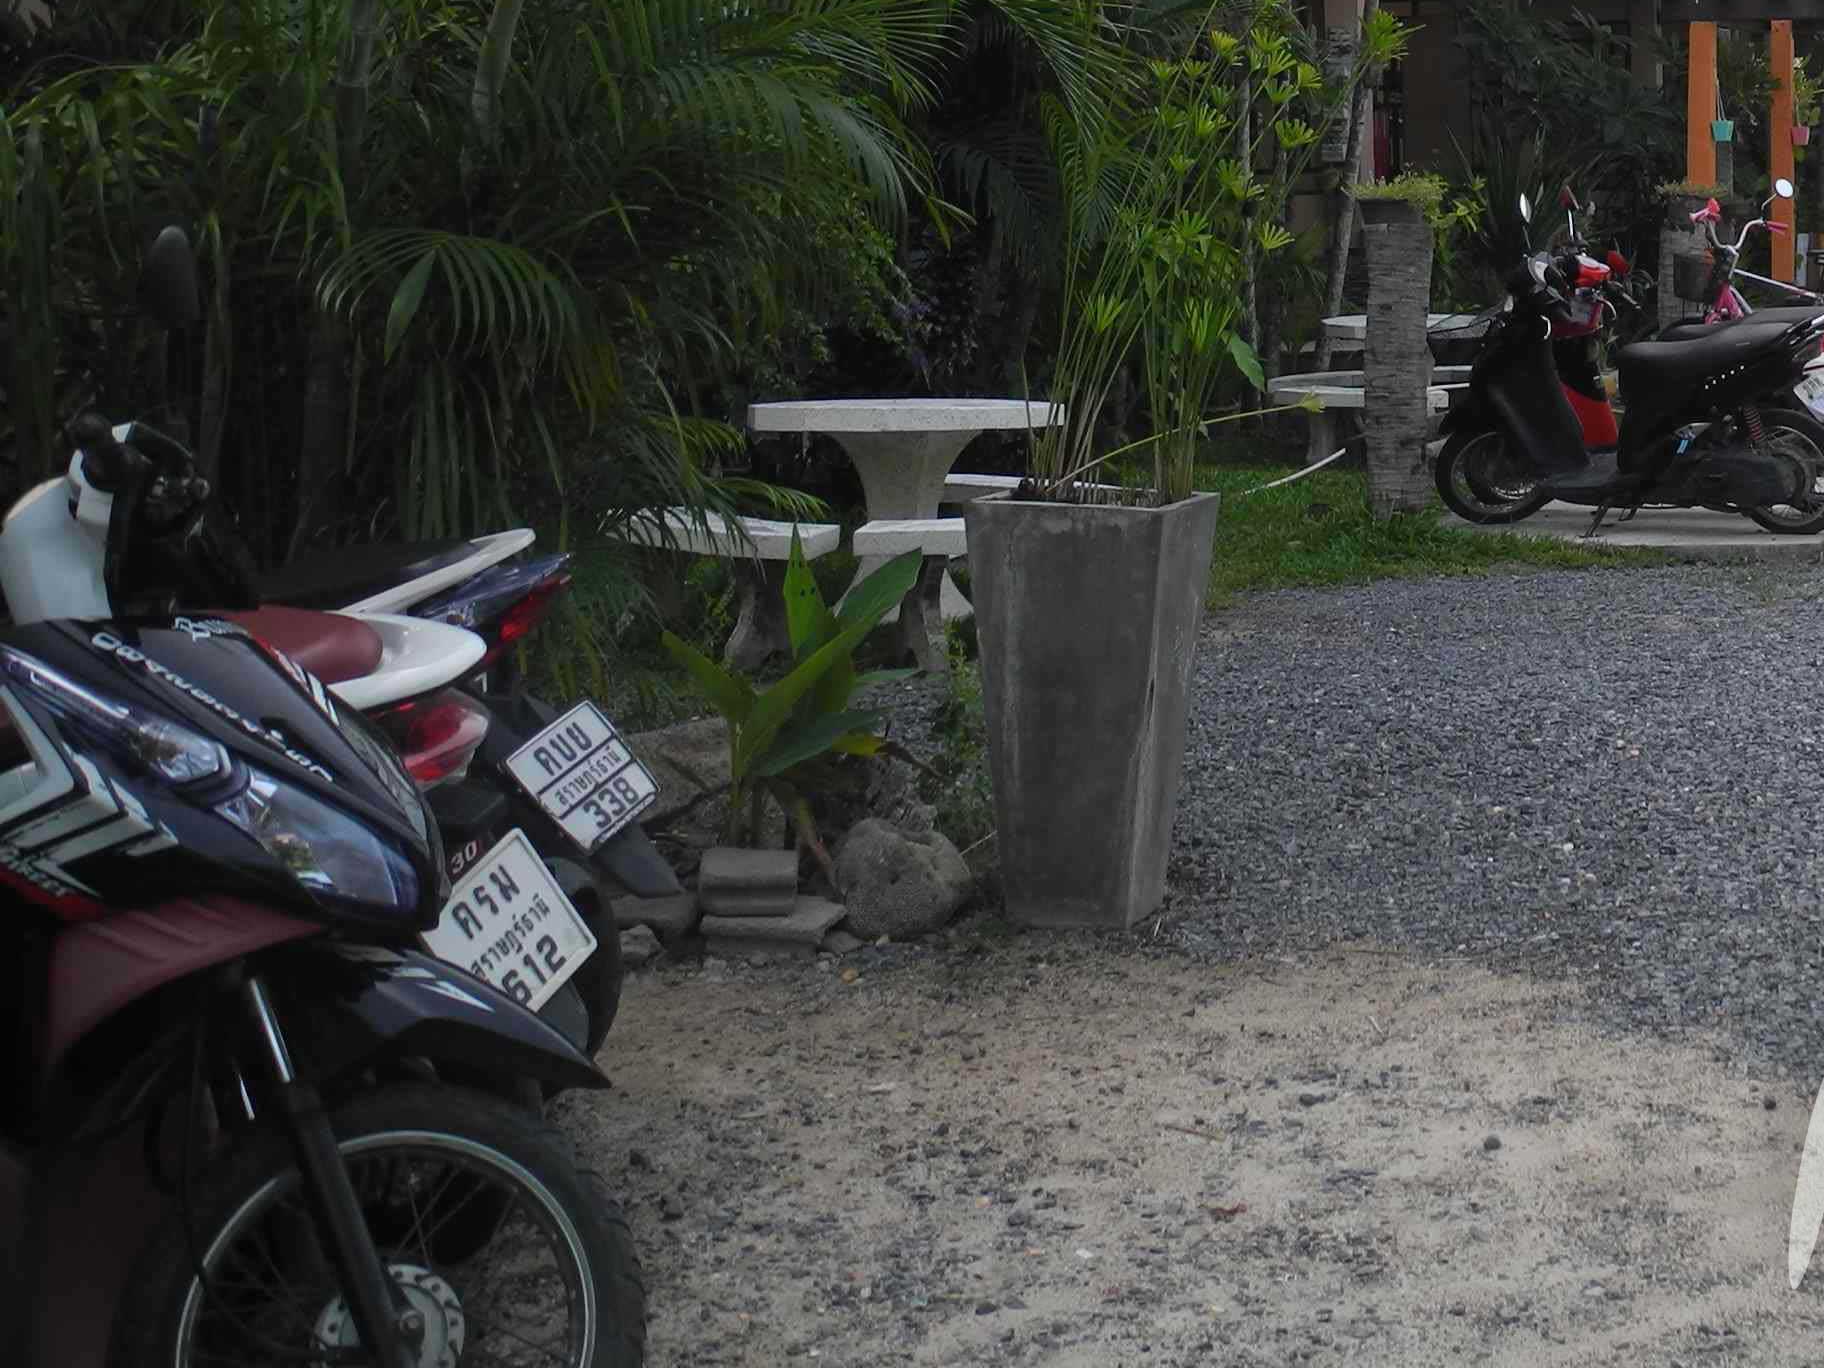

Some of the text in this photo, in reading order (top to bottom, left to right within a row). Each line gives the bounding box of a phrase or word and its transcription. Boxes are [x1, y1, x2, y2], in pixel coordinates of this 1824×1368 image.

[583, 776, 640, 829] 338
[451, 863, 520, 940] ครม
[502, 934, 567, 1007] 612
